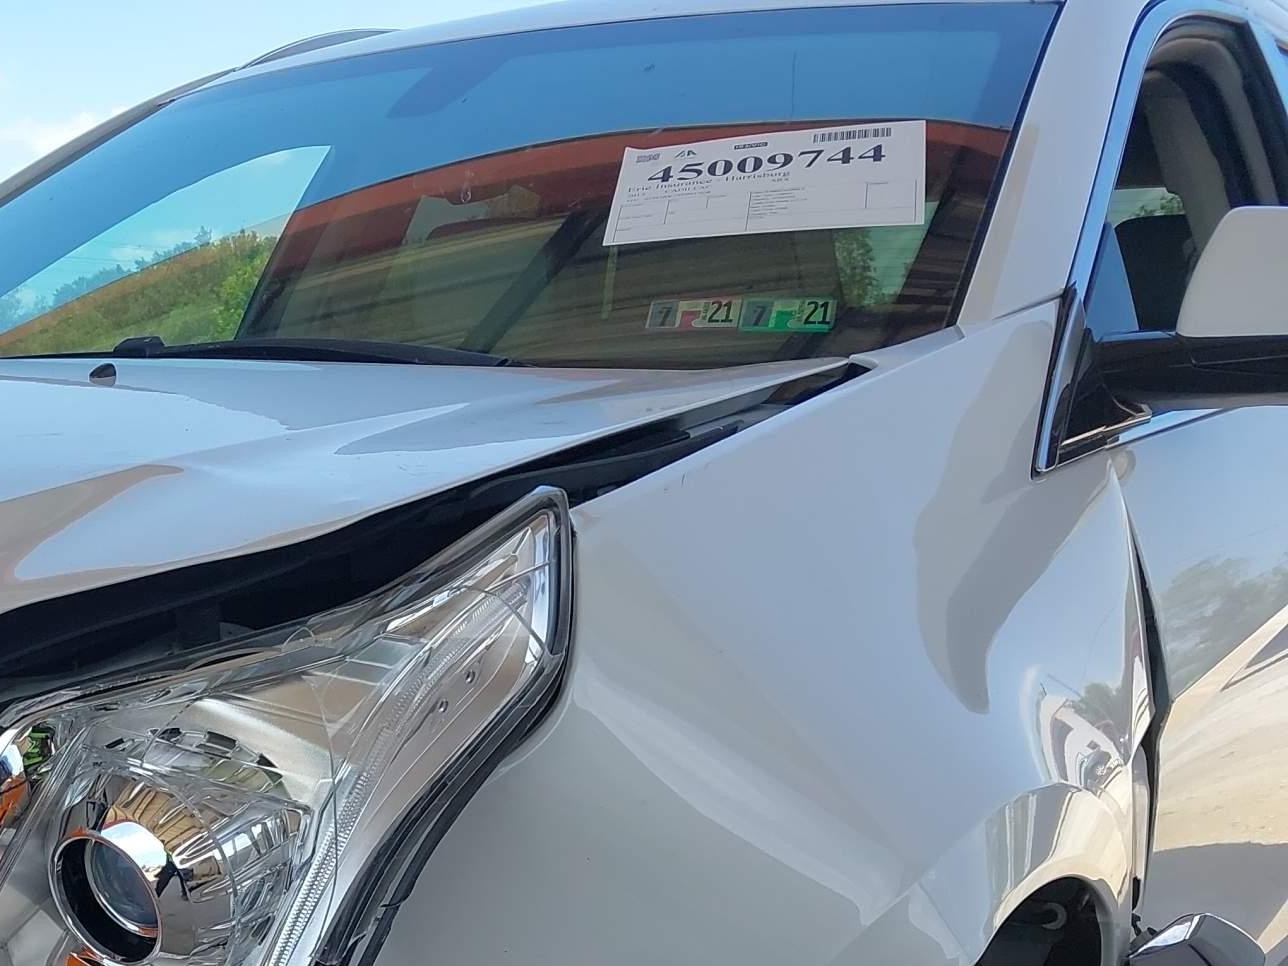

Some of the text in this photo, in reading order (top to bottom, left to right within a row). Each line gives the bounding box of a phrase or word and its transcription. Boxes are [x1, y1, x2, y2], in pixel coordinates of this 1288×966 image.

[646, 143, 887, 183] 45009744
[656, 178, 713, 189] Insurance
[724, 171, 791, 183] Harrisburg
[707, 300, 733, 323] 21
[803, 301, 831, 325] 21
